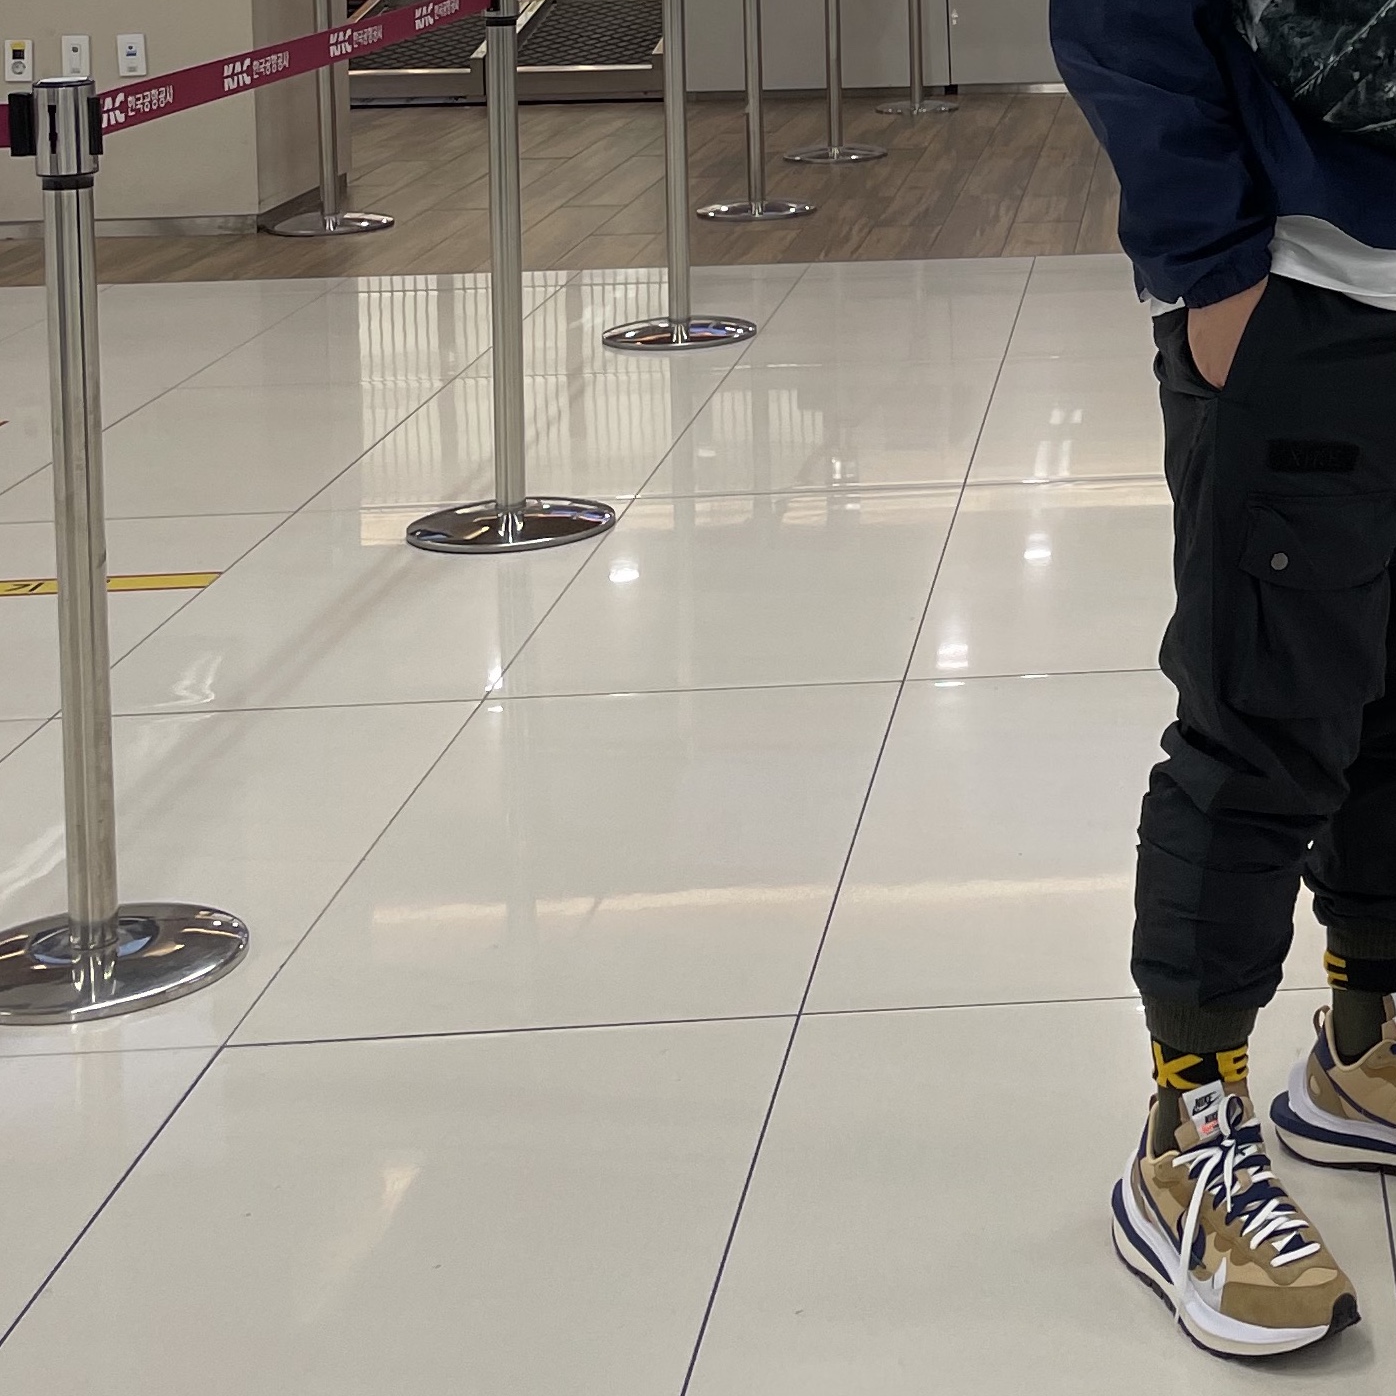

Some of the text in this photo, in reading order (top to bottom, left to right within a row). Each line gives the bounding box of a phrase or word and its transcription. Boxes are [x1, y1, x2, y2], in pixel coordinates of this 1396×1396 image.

[329, 28, 353, 57] KAC
[223, 51, 290, 92] KAC 한국공항공사
[101, 85, 174, 128] AC 한국공항공사
